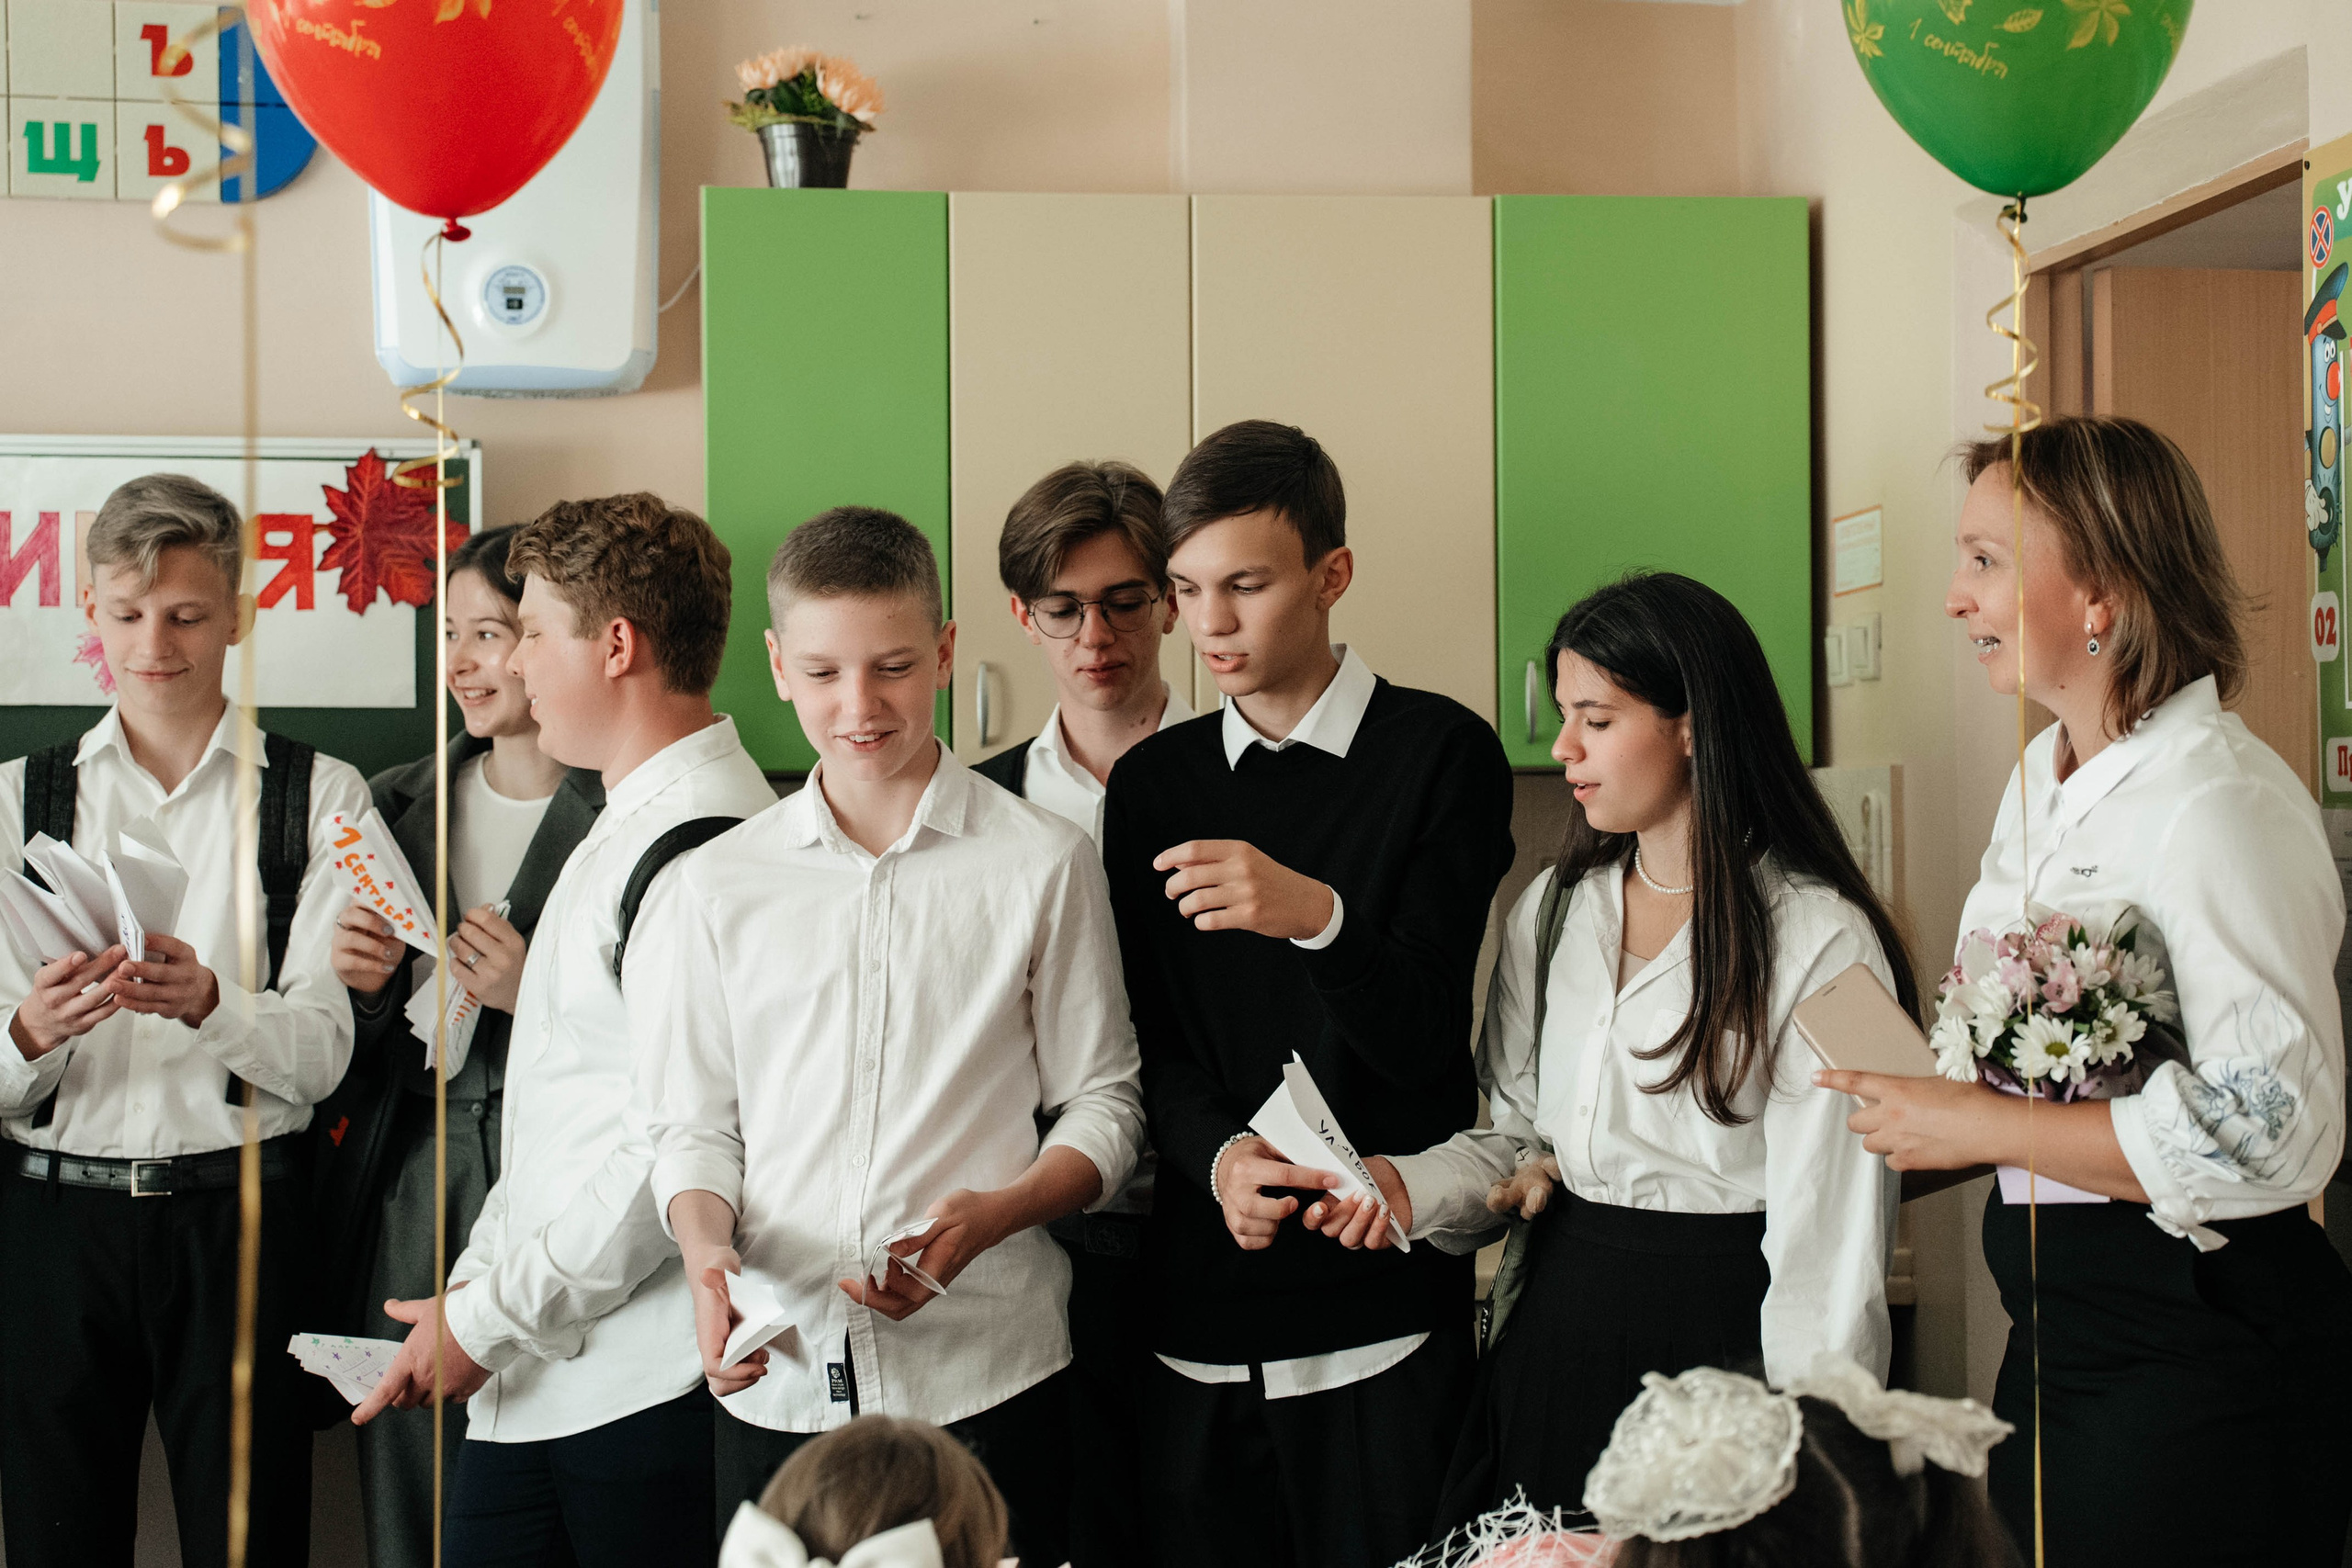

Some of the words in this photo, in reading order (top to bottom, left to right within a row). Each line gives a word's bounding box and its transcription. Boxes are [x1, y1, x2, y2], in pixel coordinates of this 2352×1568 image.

[1910, 17, 1922, 40] 1
[2314, 606, 2337, 647] 02
[334, 827, 362, 849] 1
[344, 853, 414, 931] СЕНТЯБРЯ
